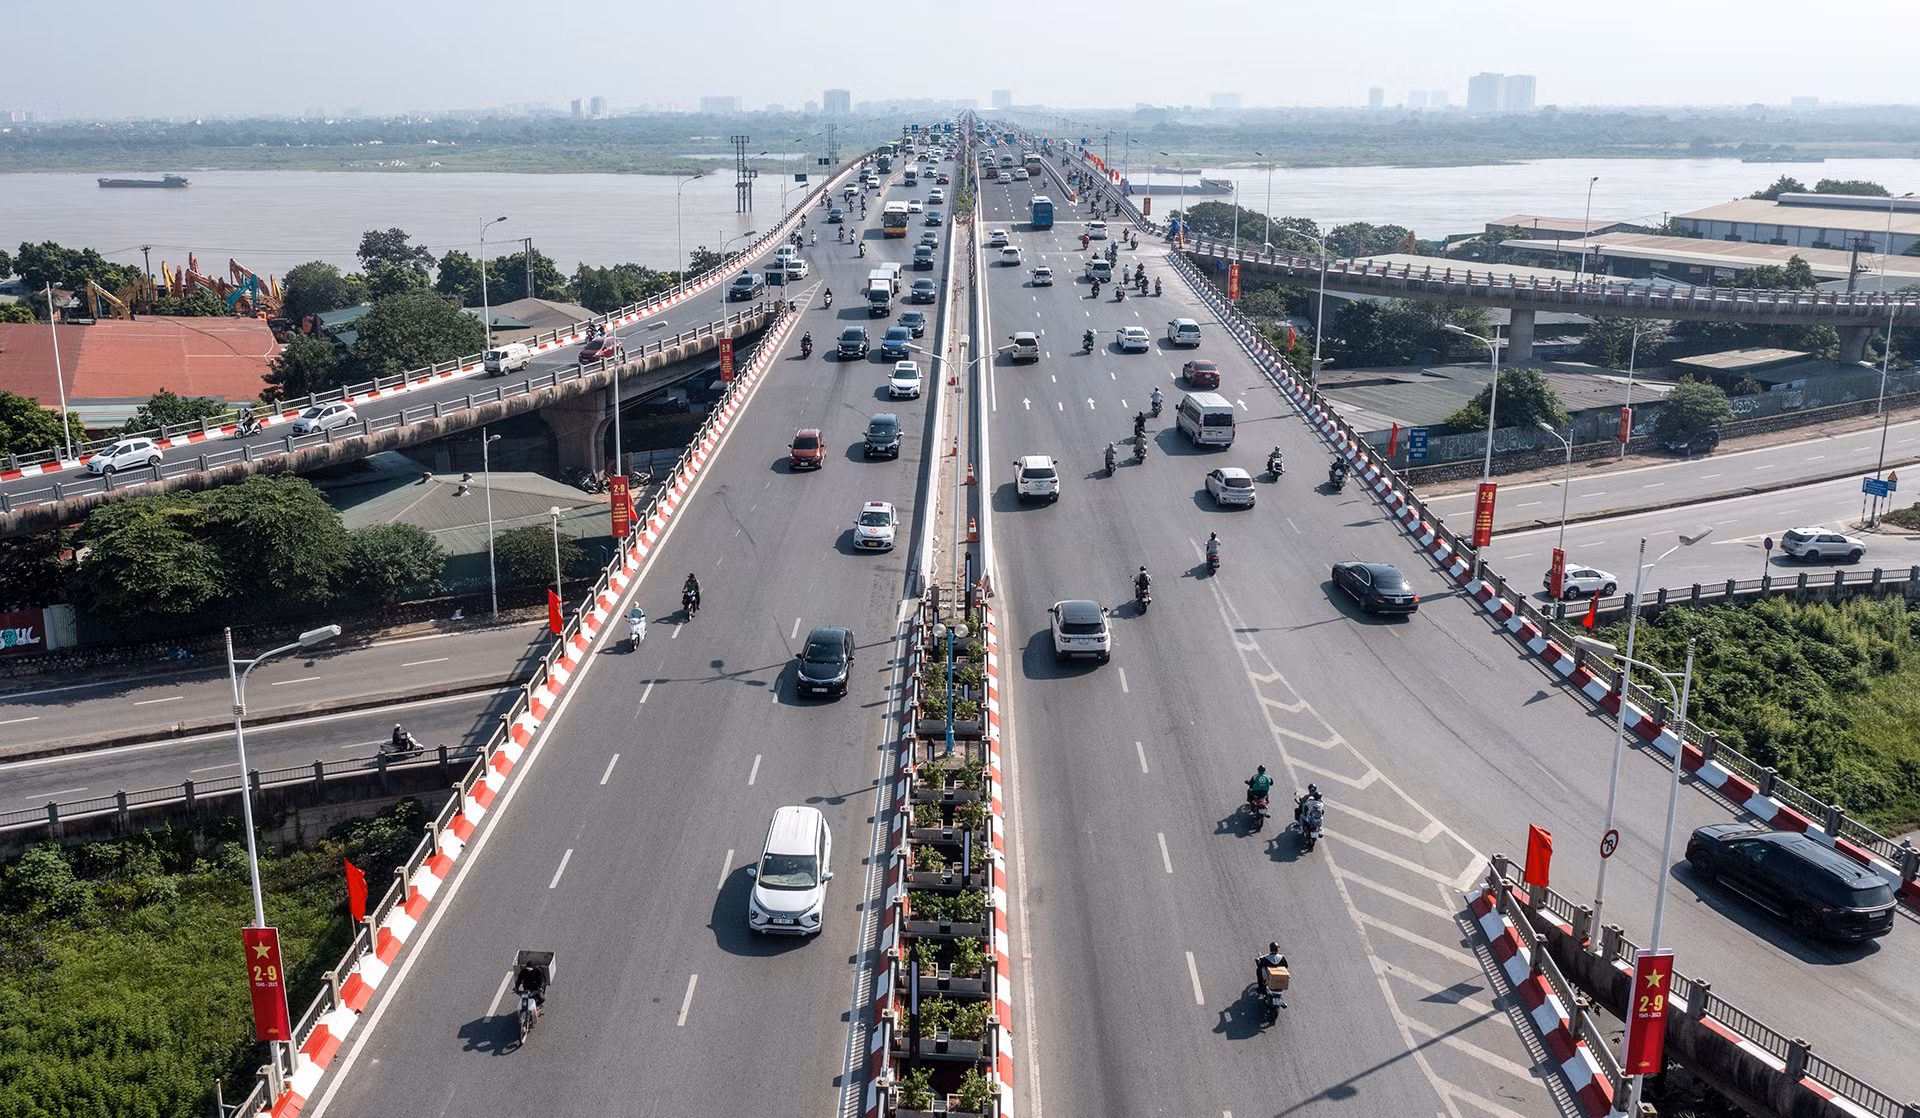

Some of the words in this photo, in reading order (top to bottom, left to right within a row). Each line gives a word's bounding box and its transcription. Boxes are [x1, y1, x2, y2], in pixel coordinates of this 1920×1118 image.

[614, 484, 625, 492] 2-9
[1481, 491, 1493, 500] 2-9
[253, 965, 277, 981] 2-9
[1638, 994, 1664, 1012] 2-9
